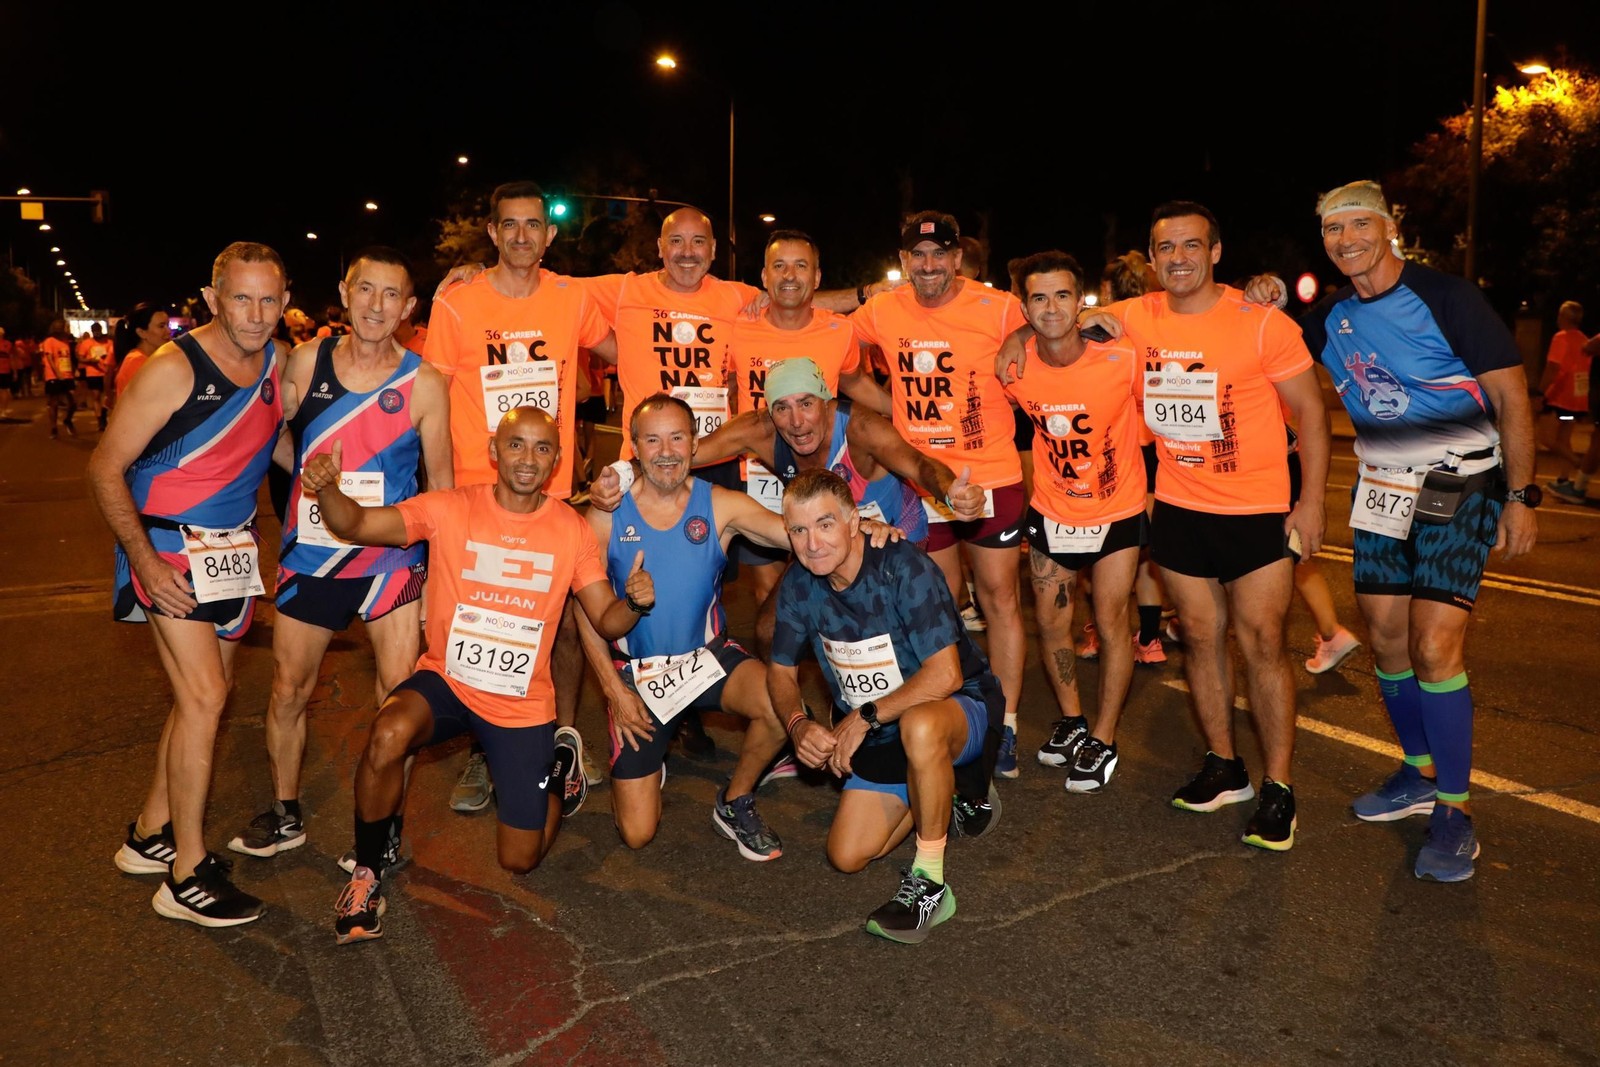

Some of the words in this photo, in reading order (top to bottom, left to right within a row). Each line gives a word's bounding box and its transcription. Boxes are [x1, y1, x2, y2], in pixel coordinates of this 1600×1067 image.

[653, 309, 668, 319] 36
[485, 330, 501, 340] 36
[502, 330, 543, 340] CARRERA
[898, 338, 910, 348] 36
[912, 340, 950, 349] CARRERA
[653, 347, 712, 368] TUR
[750, 357, 762, 367] 36
[1146, 347, 1158, 358] 36
[1160, 349, 1203, 359] CARRERA
[660, 370, 702, 391] NA
[901, 377, 953, 397] TUR
[312, 392, 333, 400] VIATOR
[497, 390, 550, 413] 8258
[906, 400, 942, 421] NA
[1027, 401, 1040, 411] 36
[1042, 403, 1086, 413] CARRERA
[1155, 402, 1207, 424] 9184
[696, 415, 722, 434] 189
[758, 479, 778, 496] 71
[1366, 489, 1414, 518] 8473
[204, 552, 252, 578] 8483
[469, 590, 536, 611] JULIAN
[455, 640, 530, 675] 13192
[648, 653, 704, 699] 8472
